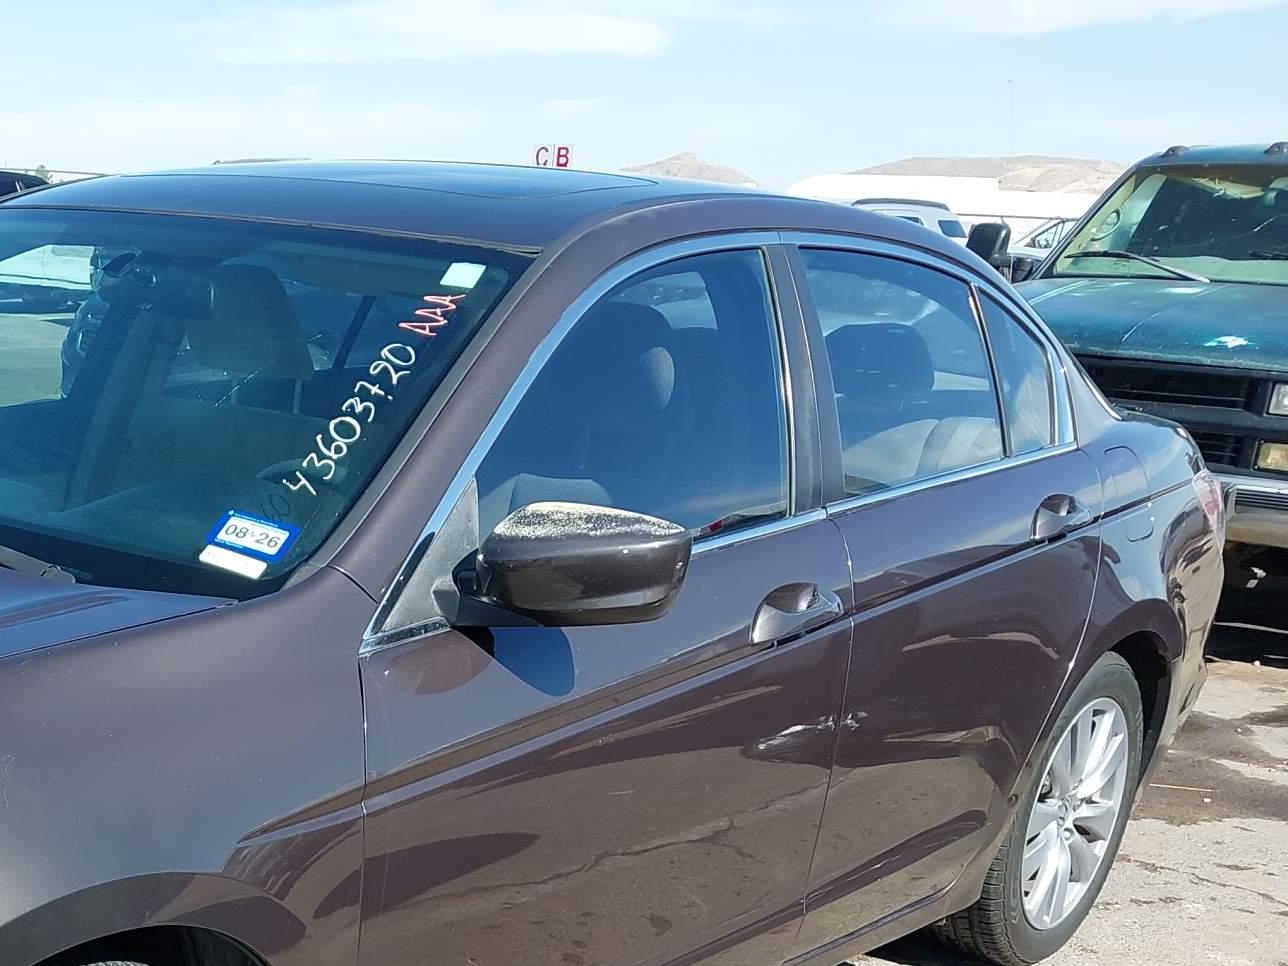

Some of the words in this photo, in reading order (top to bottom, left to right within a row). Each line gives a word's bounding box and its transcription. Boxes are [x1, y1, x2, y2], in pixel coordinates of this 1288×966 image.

[535, 146, 549, 167] C
[556, 146, 570, 168] B
[282, 343, 416, 496] 43603720
